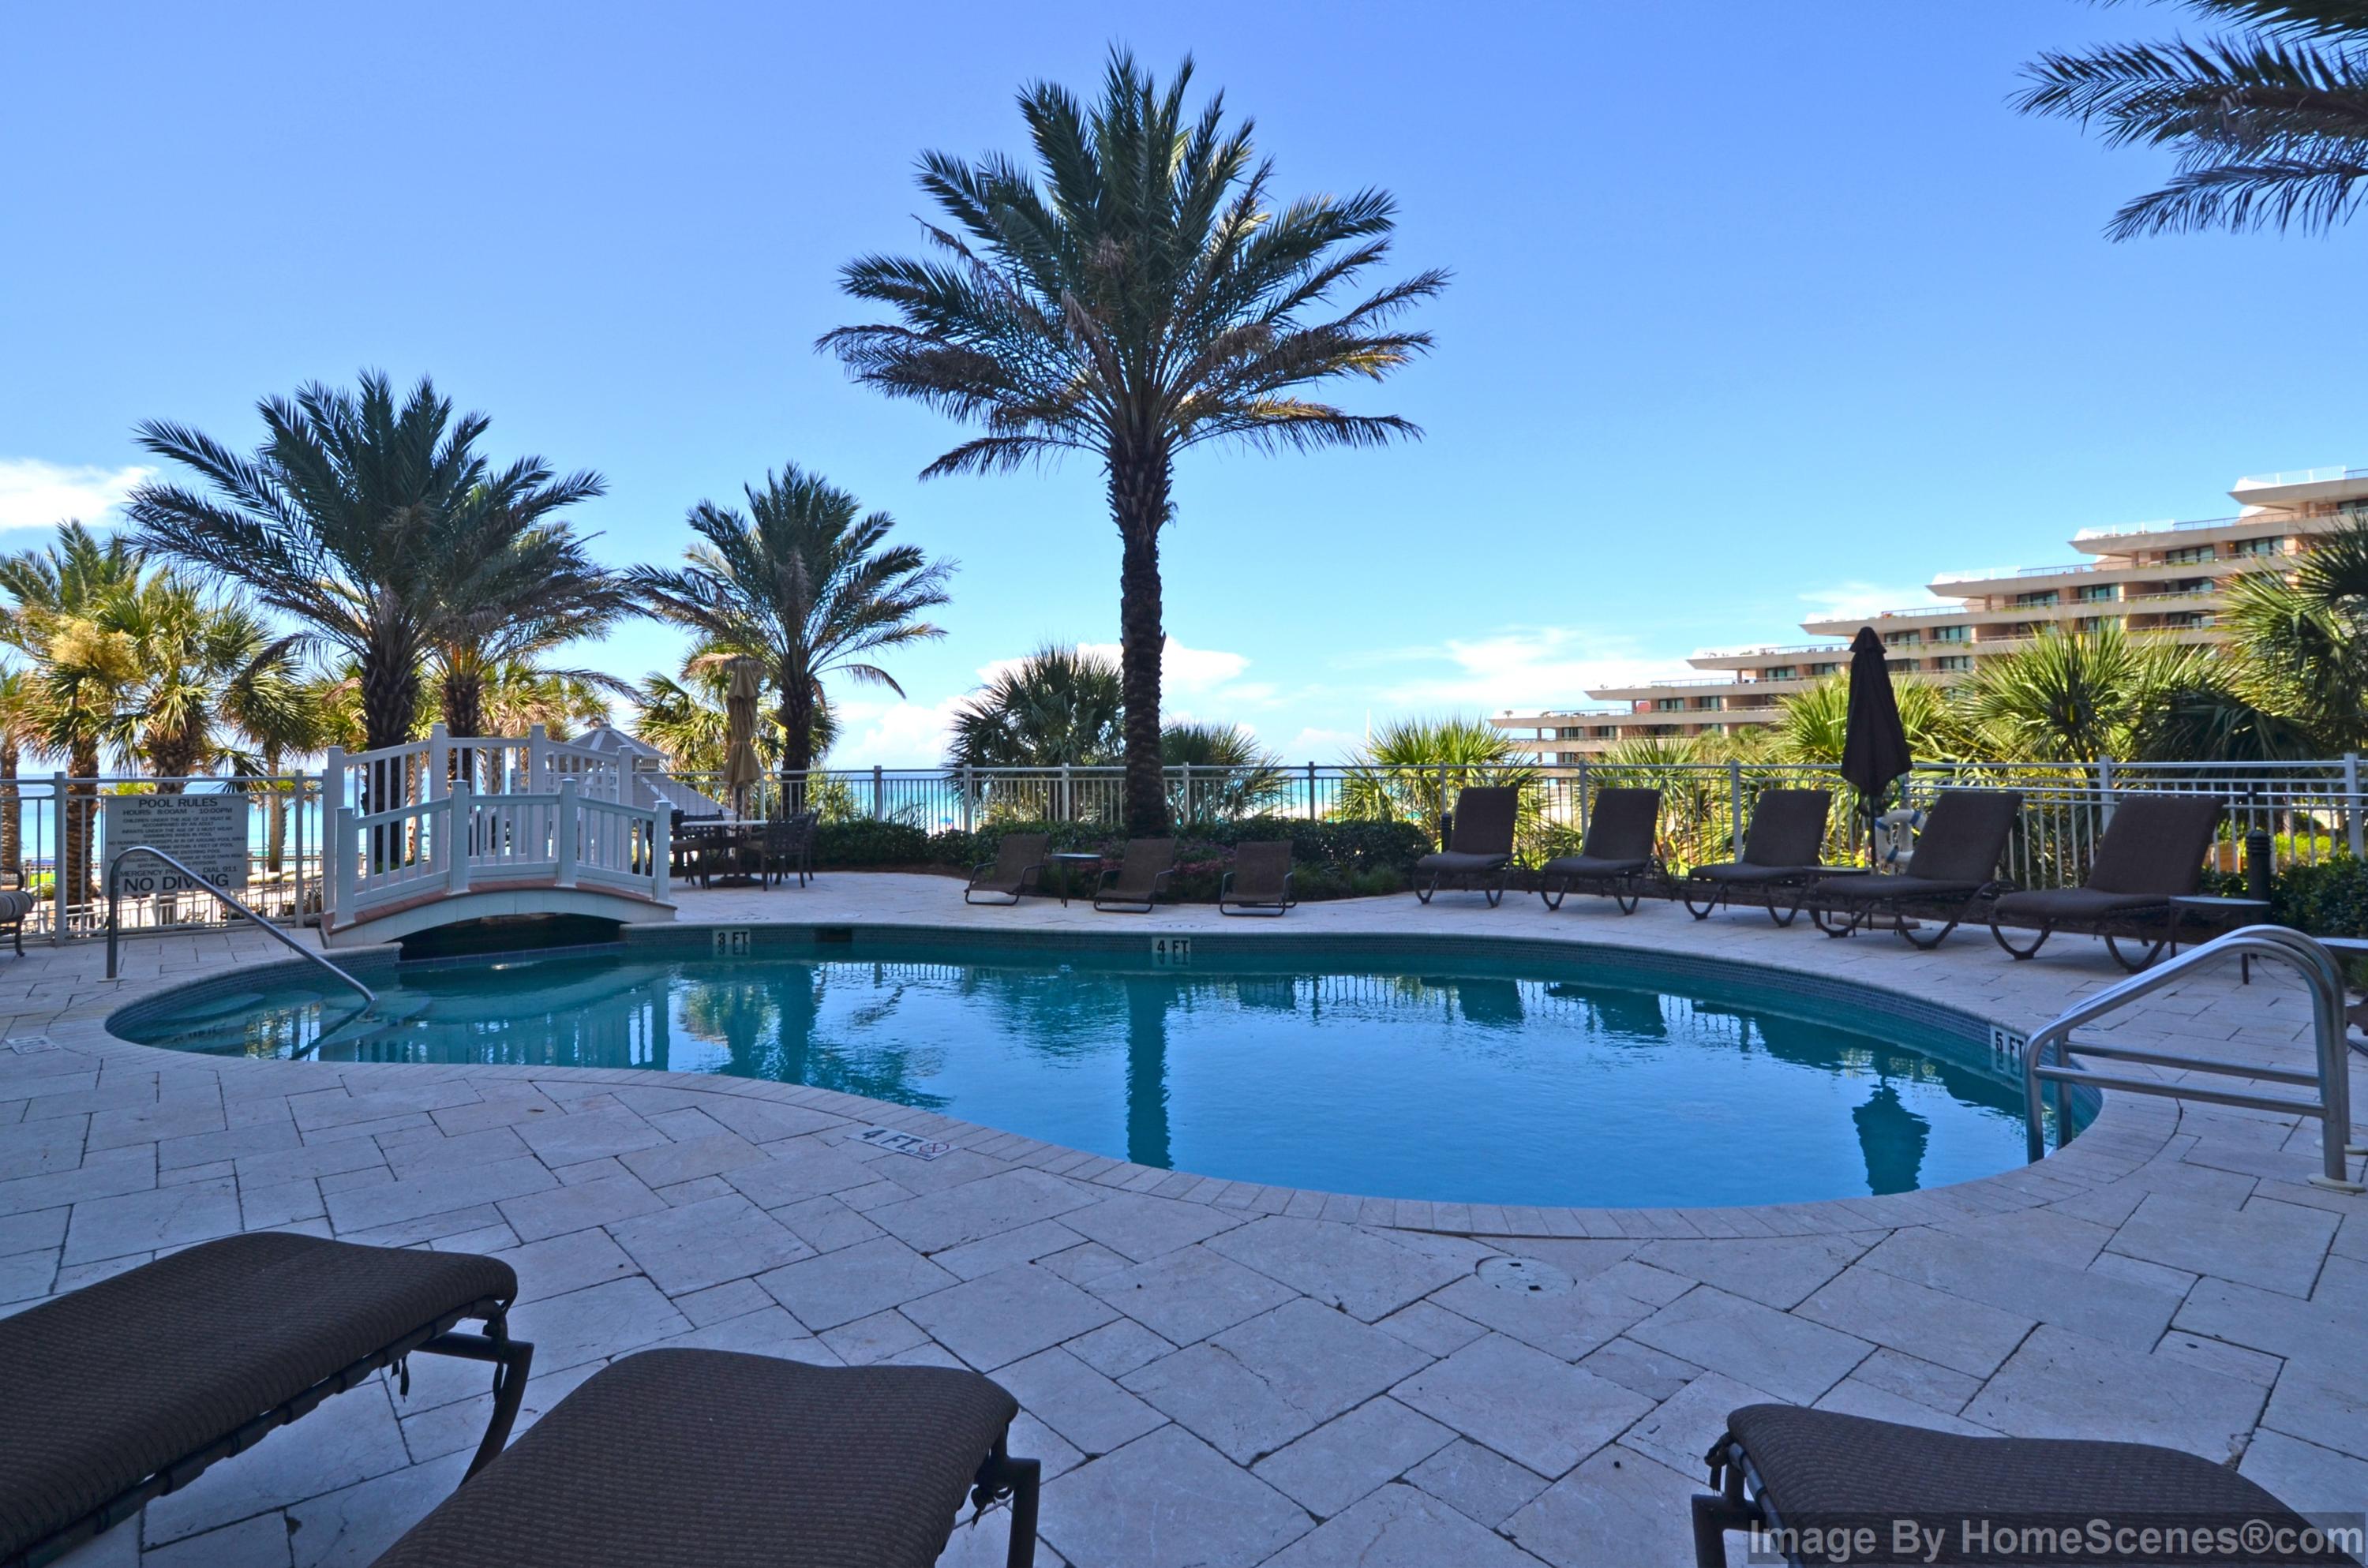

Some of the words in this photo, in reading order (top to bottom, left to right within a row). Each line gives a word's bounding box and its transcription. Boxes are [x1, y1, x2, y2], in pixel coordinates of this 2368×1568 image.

[138, 799, 173, 808] POOL
[178, 798, 218, 807] RULES
[125, 877, 155, 893] NO
[163, 873, 229, 891] DIVNG
[718, 932, 725, 945] 3
[1157, 940, 1167, 953] 4
[1995, 1031, 2004, 1052] 5
[861, 1129, 887, 1140] 4
